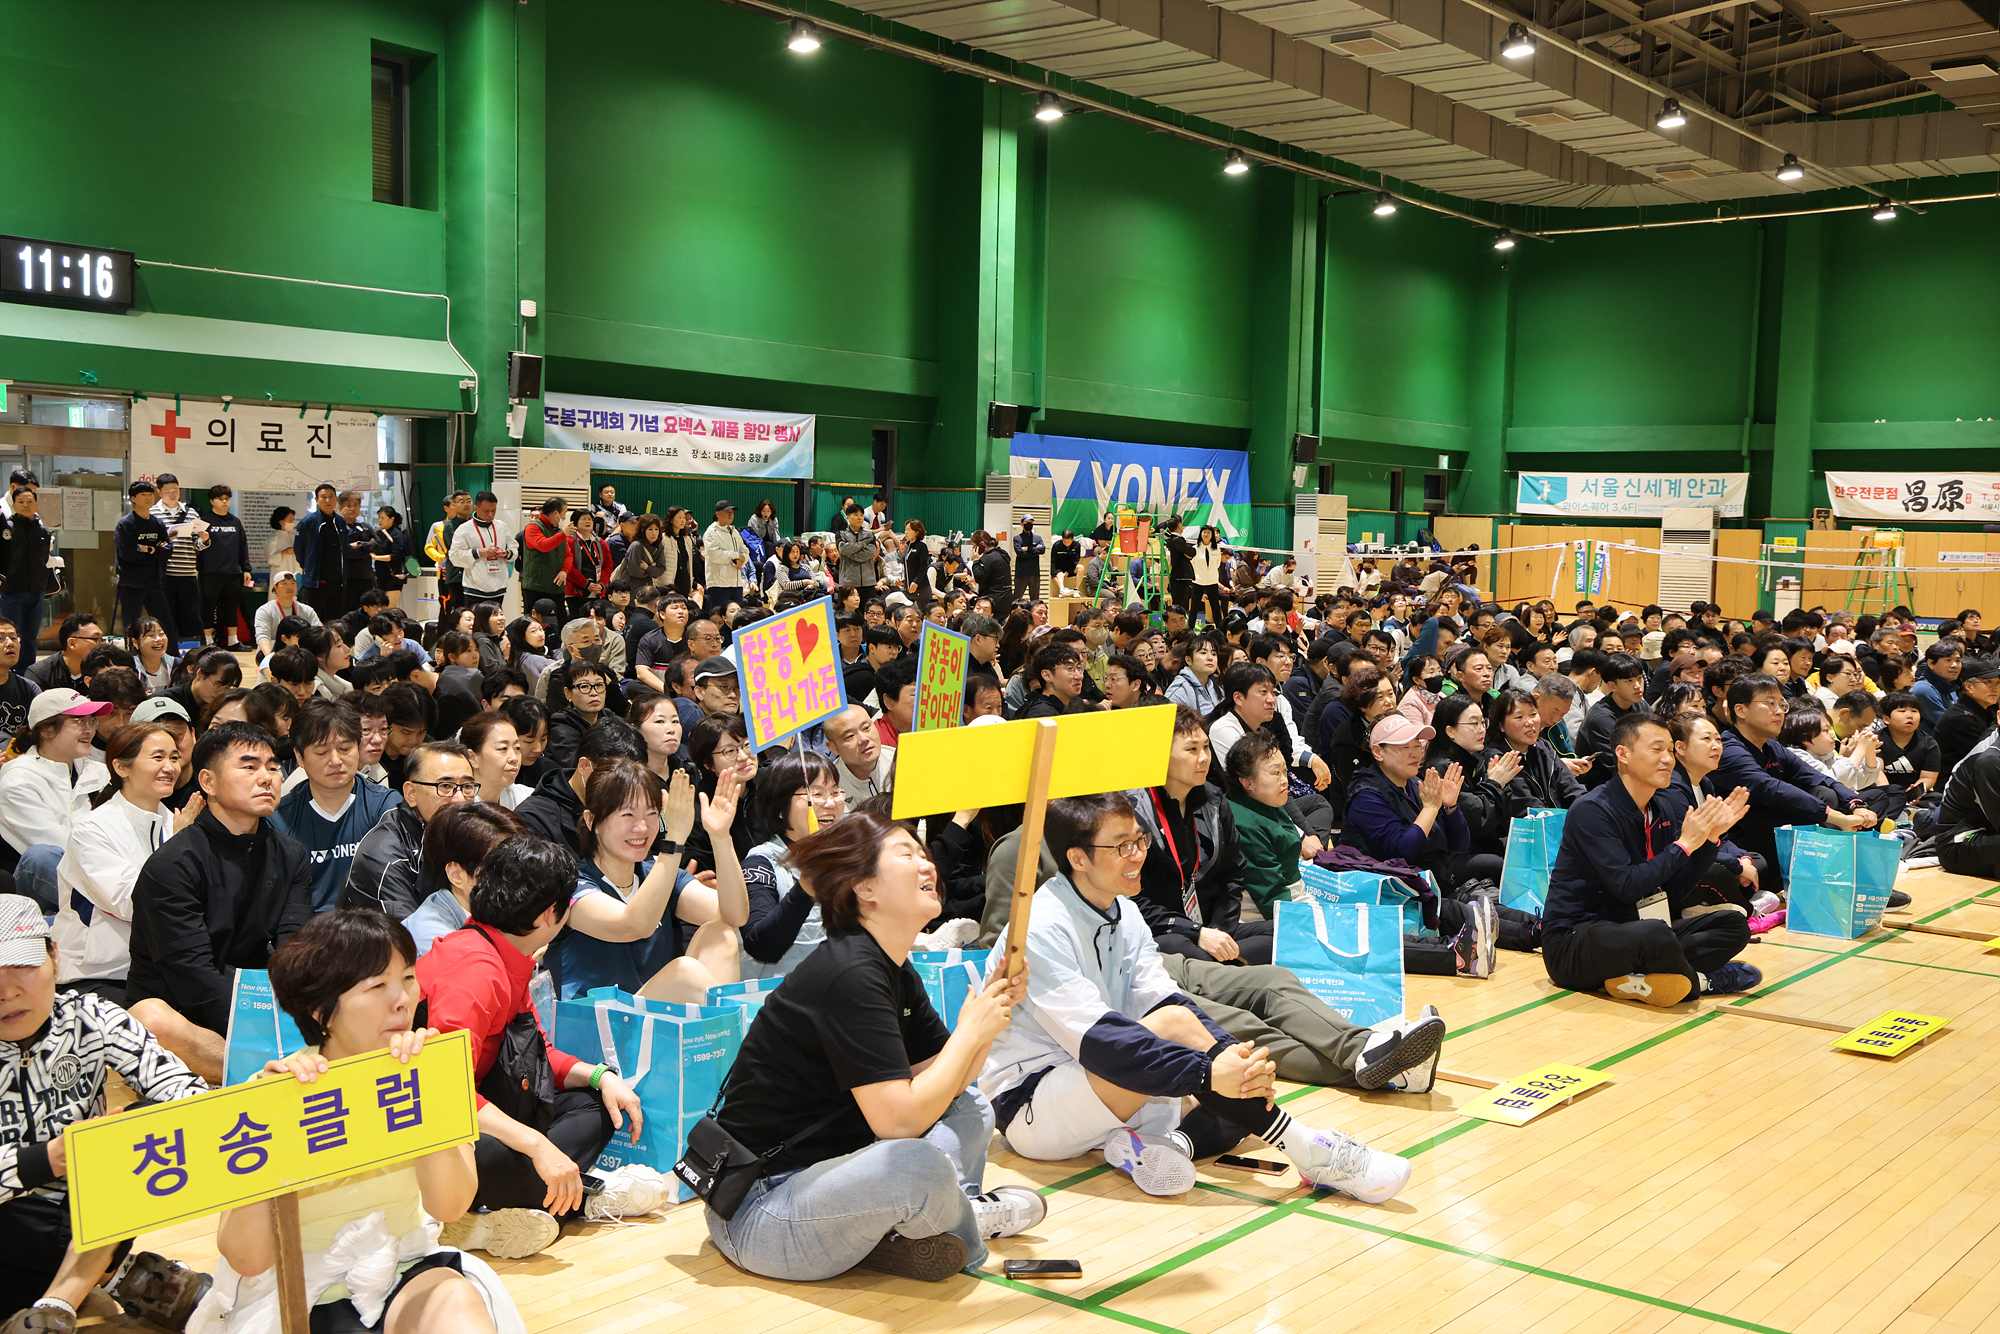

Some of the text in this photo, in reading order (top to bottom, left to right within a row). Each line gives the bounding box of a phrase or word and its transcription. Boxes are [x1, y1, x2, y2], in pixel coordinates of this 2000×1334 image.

[19, 245, 113, 298] 11:16
[544, 406, 801, 442] 도봉구대회 기념 요넥스 제품 할인 행사
[582, 442, 615, 454] 행사주최:
[617, 445, 641, 456] 요넥스,
[644, 446, 679, 457] 미르스포츠
[713, 451, 734, 461] 대회장
[735, 452, 746, 462] 2층
[748, 453, 761, 463] 중앙
[1091, 460, 1241, 539] YONEX
[1581, 477, 1728, 499] 서울신세계안과
[1834, 485, 1899, 500] 한우전문점
[1902, 479, 1965, 513] 昌原
[1562, 502, 1609, 512] 와이스퀘어
[1577, 542, 1583, 550] 3
[1576, 567, 1584, 590] YONEX
[1590, 569, 1601, 592] YONEX
[742, 621, 793, 690] 창동
[929, 632, 963, 686] 창동이
[751, 663, 839, 741] 잘나가쥬
[1305, 885, 1340, 903] 1599-7397
[241, 983, 256, 991] New
[1492, 1073, 1583, 1110] 창경클럽
[132, 1068, 424, 1197] 청송클럽
[682, 1165, 702, 1187] YONEX
